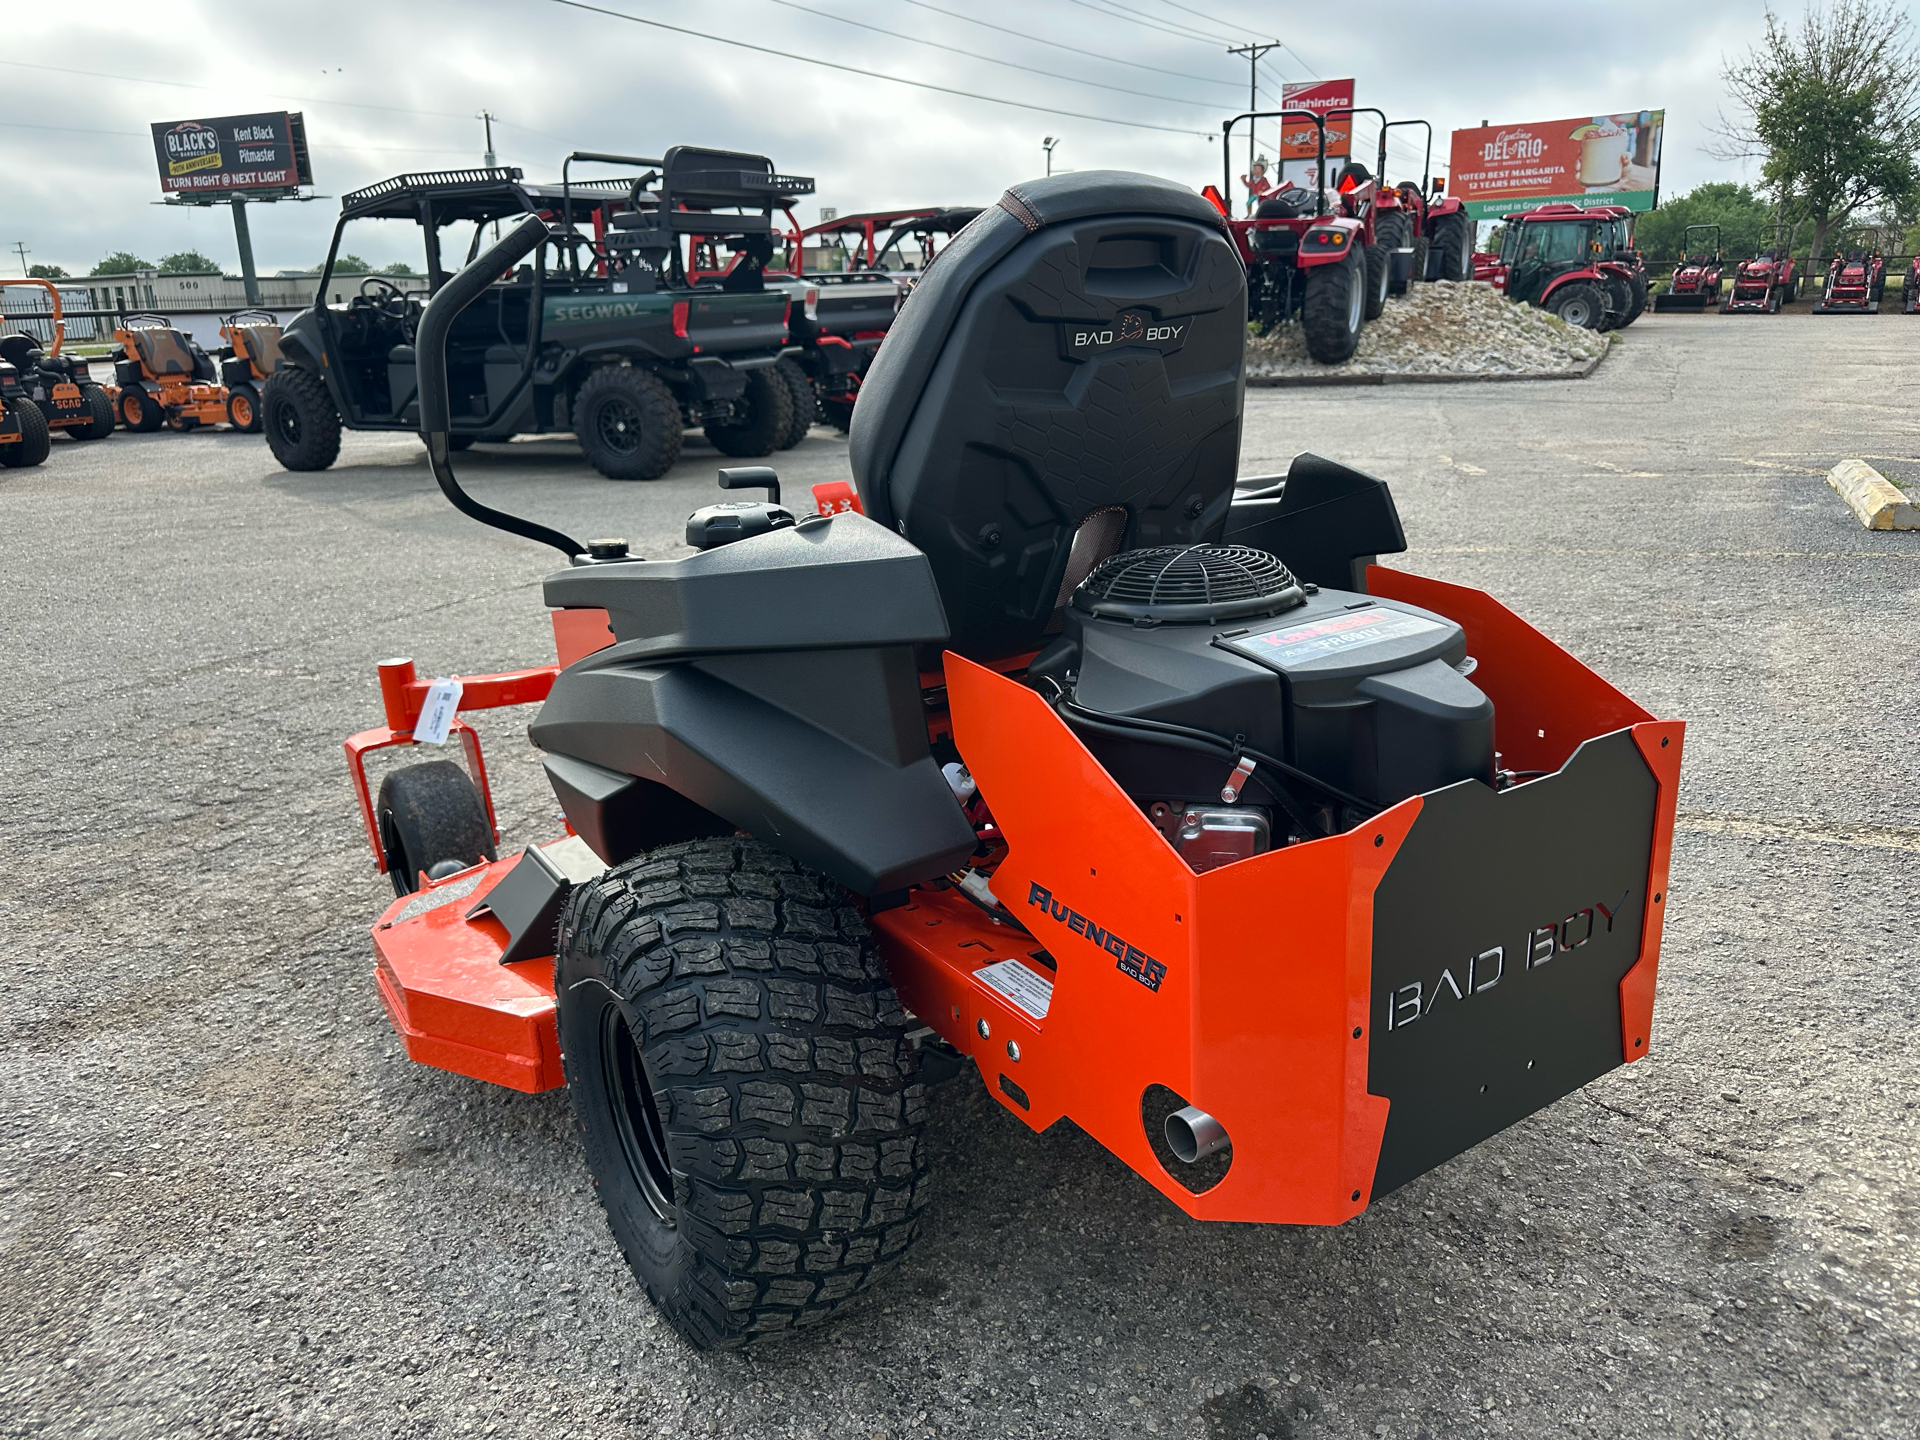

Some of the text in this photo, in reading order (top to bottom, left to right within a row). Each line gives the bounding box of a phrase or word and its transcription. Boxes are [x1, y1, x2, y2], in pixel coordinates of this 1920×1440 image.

[1286, 97, 1348, 109] Mahindra
[168, 131, 216, 152] BLACK'S
[234, 125, 274, 142] Kent Black
[239, 148, 275, 163] Pitmaster
[1484, 138, 1542, 161] DEL RIO
[186, 155, 218, 170] ANNIVERSARY
[167, 170, 286, 188] TURN RIGHT @ NEXT LIGHT
[1458, 166, 1565, 181] VOTED BEST MARGARITA
[1480, 180, 1508, 188] YEARS
[1510, 176, 1552, 186] RUNNING!
[1484, 203, 1512, 212] Located
[1514, 202, 1521, 210] in
[1583, 197, 1614, 206] District
[469, 230, 533, 287] BAD
[179, 281, 198, 290] 500
[555, 303, 638, 321] SEGWAY
[1075, 326, 1183, 346] BAD BOY
[56, 399, 81, 410] SCAG
[1260, 613, 1389, 646] Kawasaki
[1319, 628, 1382, 648] FR691V
[1028, 880, 1168, 985] AVENGER
[1388, 889, 1630, 1032] BAD BOY
[1120, 962, 1156, 988] BAD BOY
